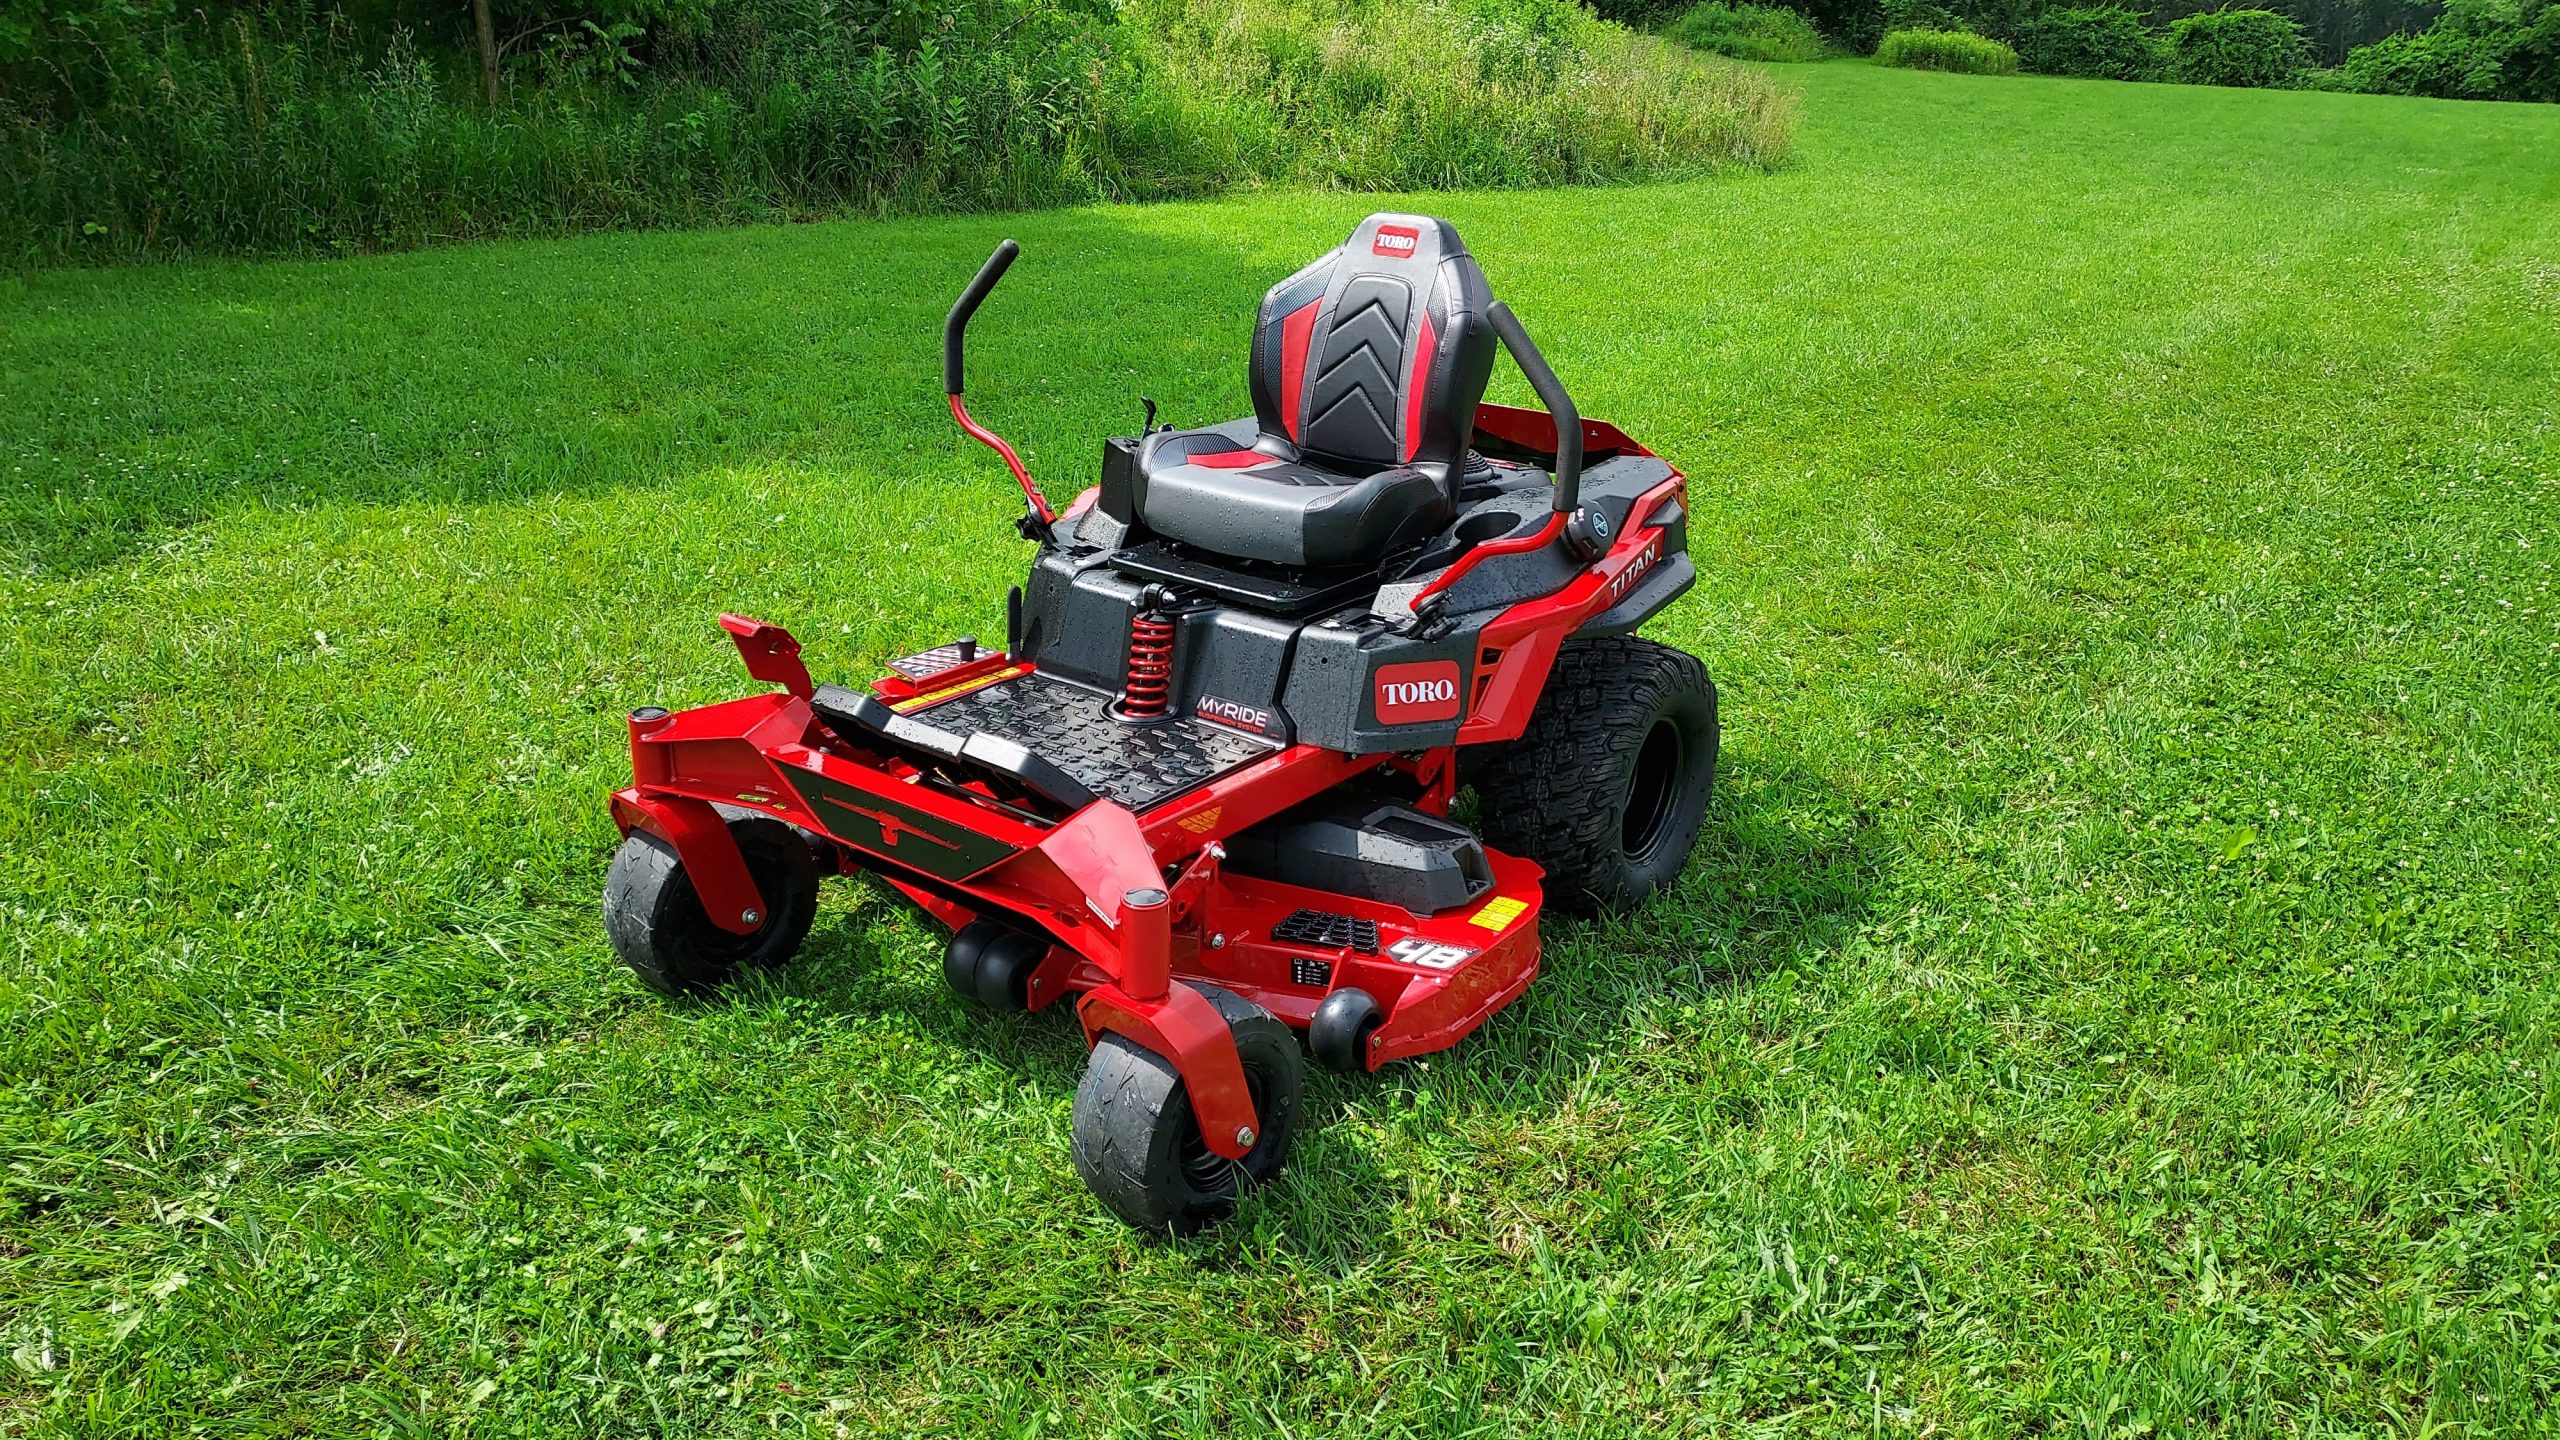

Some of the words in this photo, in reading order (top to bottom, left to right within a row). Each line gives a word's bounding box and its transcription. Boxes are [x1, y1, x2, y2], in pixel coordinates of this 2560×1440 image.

[1377, 233, 1415, 249] TORO
[1611, 544, 1656, 598] TITAN
[1382, 679, 1454, 705] TORO
[1390, 940, 1468, 969] 48
